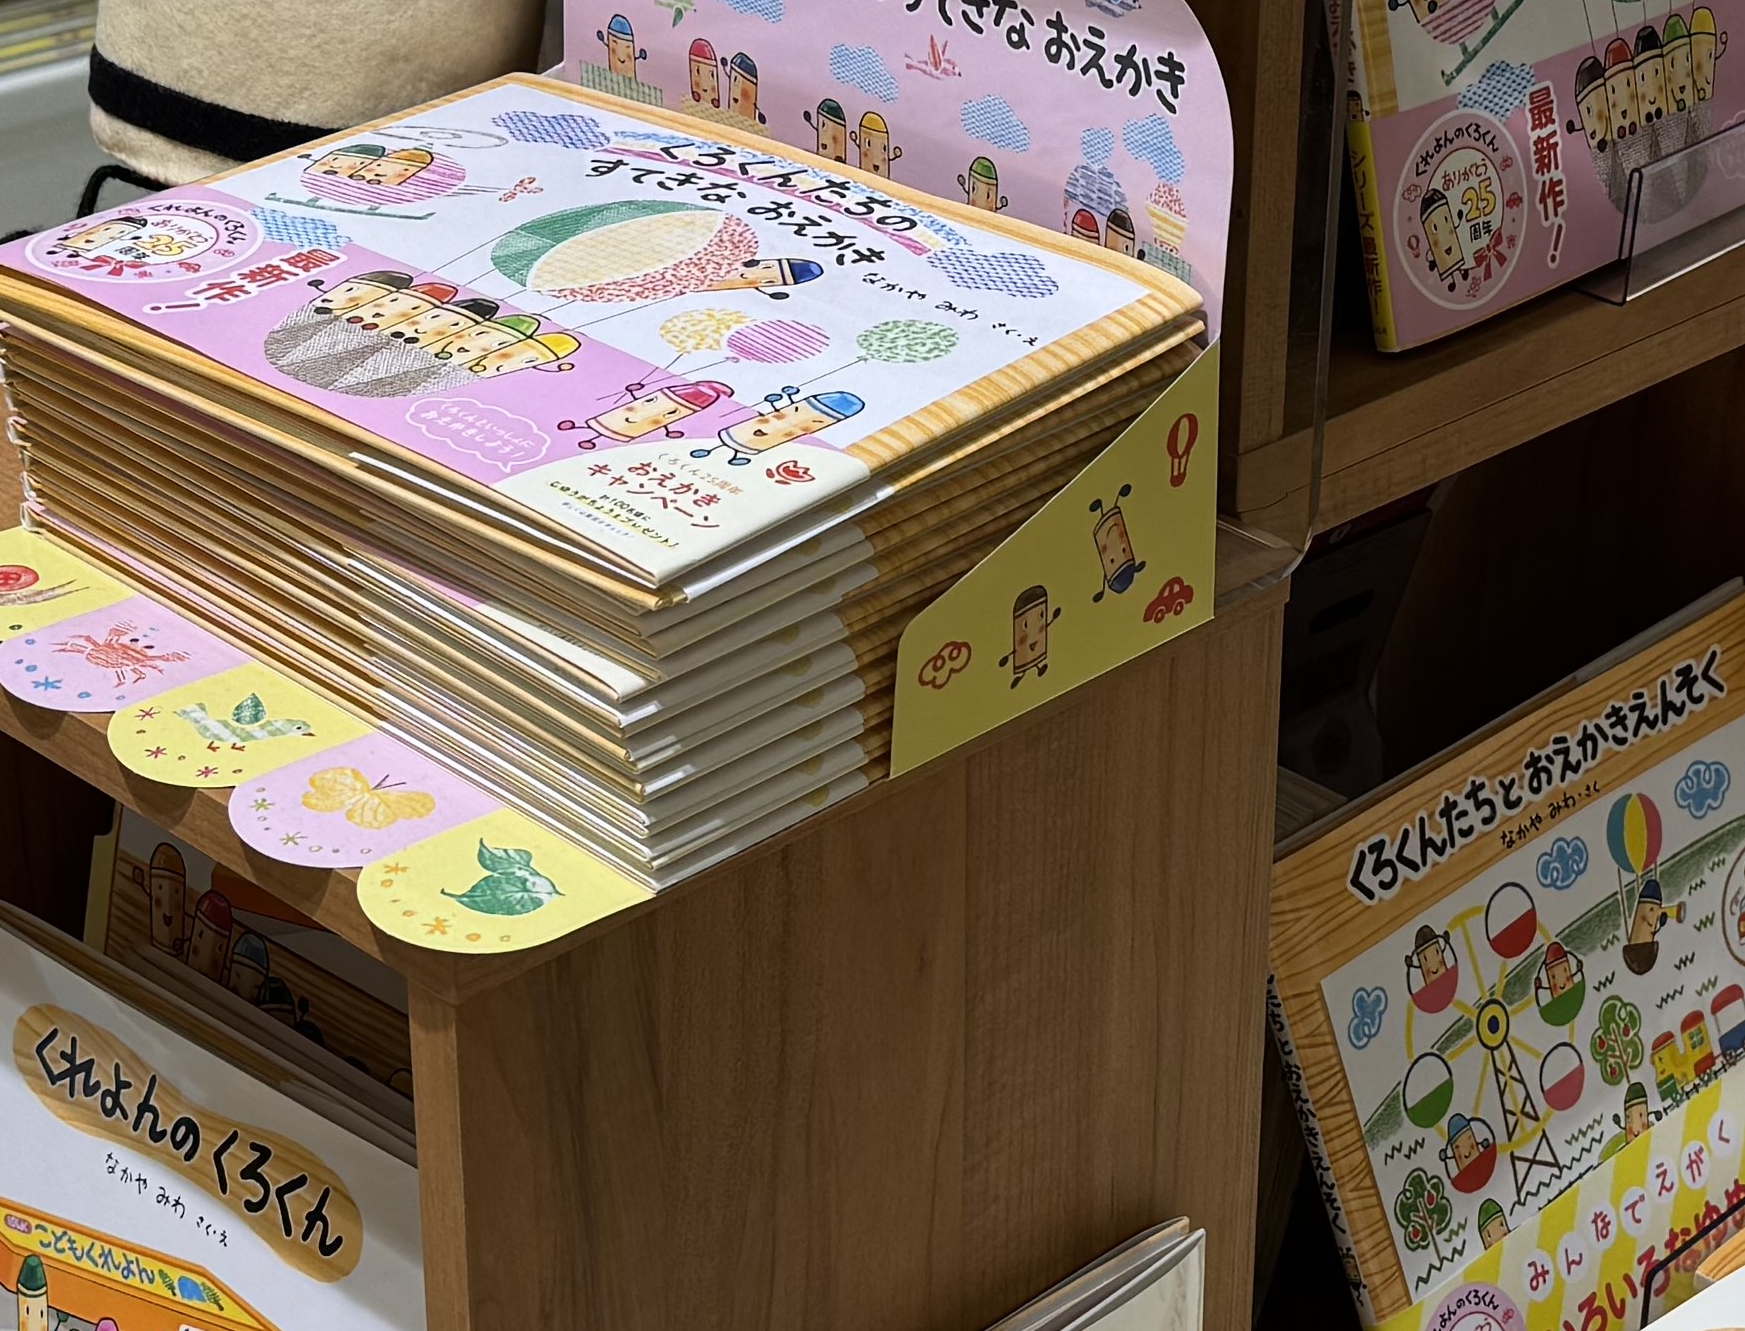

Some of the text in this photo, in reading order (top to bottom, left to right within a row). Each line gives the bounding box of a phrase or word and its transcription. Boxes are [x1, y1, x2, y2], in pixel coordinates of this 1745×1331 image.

[660, 142, 918, 233] くろくんたちの
[1527, 89, 1567, 266] 最新作!
[1468, 217, 1495, 245] 周年
[149, 248, 342, 312] 最新作!
[587, 463, 721, 530] キャンペーン
[628, 461, 722, 508] おえかき
[1348, 647, 1727, 906] くろくんたちとおえかきえんそく
[34, 1027, 349, 1260] くれよんのくろくん
[1523, 1112, 1734, 1296] みんなでえがく
[32, 1221, 159, 1286] こどもくれよん
